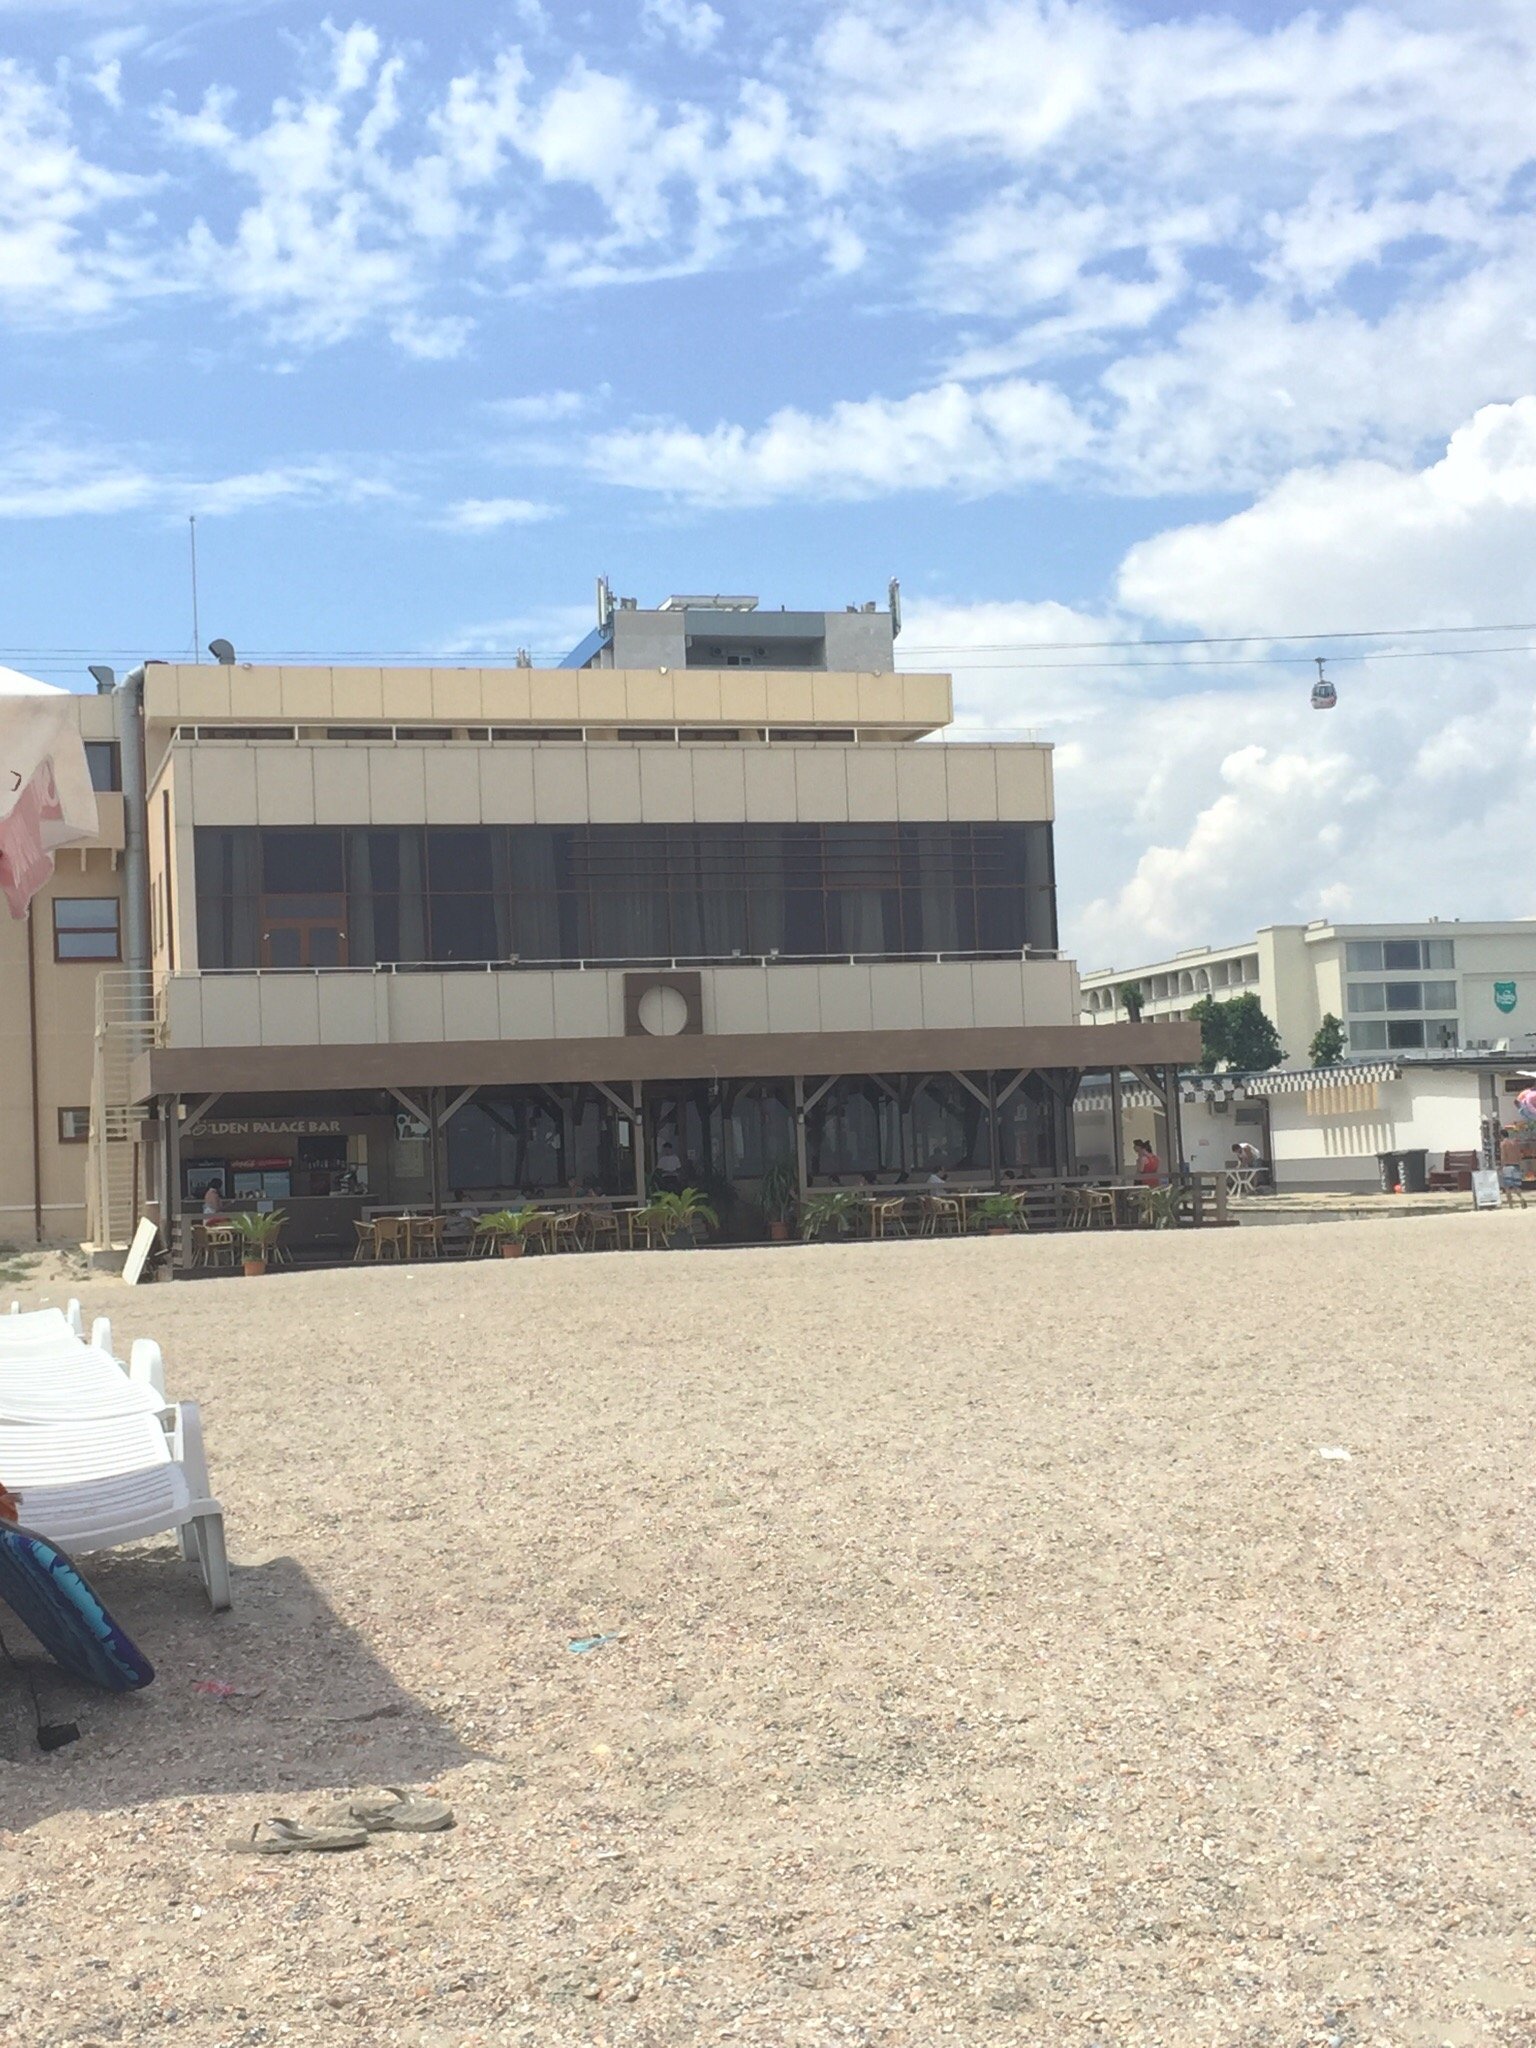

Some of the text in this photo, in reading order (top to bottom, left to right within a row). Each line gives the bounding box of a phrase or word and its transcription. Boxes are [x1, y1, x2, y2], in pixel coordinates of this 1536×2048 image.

[184, 1120, 341, 1136] OLDEN PALACE BAR
